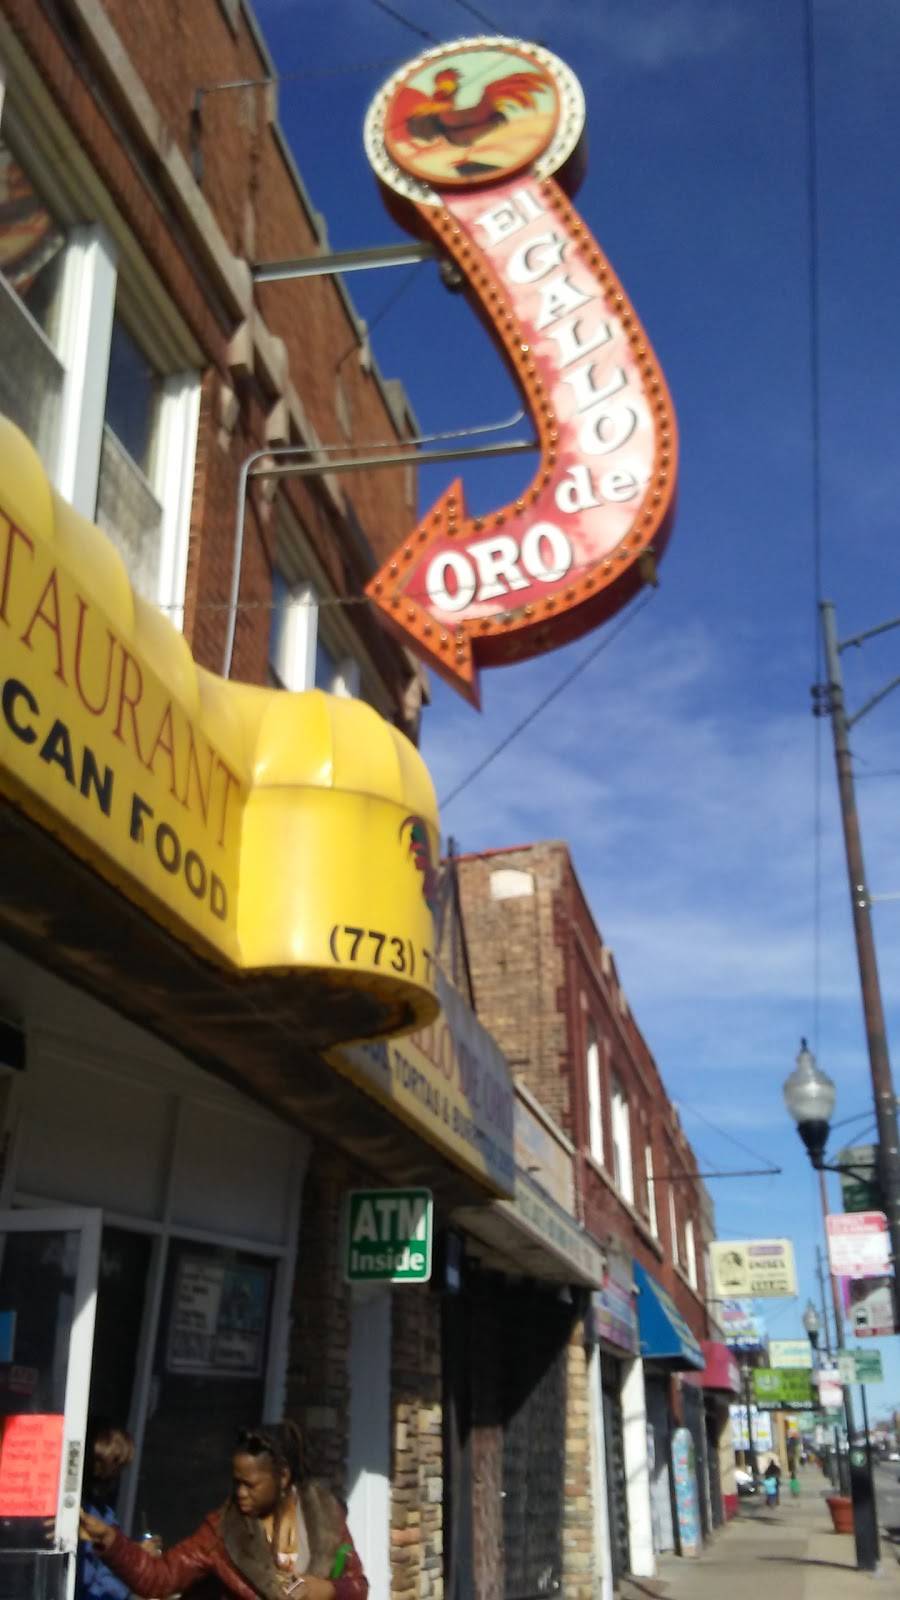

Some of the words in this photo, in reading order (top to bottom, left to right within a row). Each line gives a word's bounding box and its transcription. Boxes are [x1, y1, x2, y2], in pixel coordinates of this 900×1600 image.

[505, 233, 638, 455] GALLO
[555, 466, 640, 516] de
[425, 522, 574, 612] ORO
[2, 678, 114, 818] CAN
[129, 792, 228, 921] FOOD
[329, 924, 415, 977] (773)
[352, 1199, 426, 1242] ATM
[351, 1247, 425, 1272] Inside
